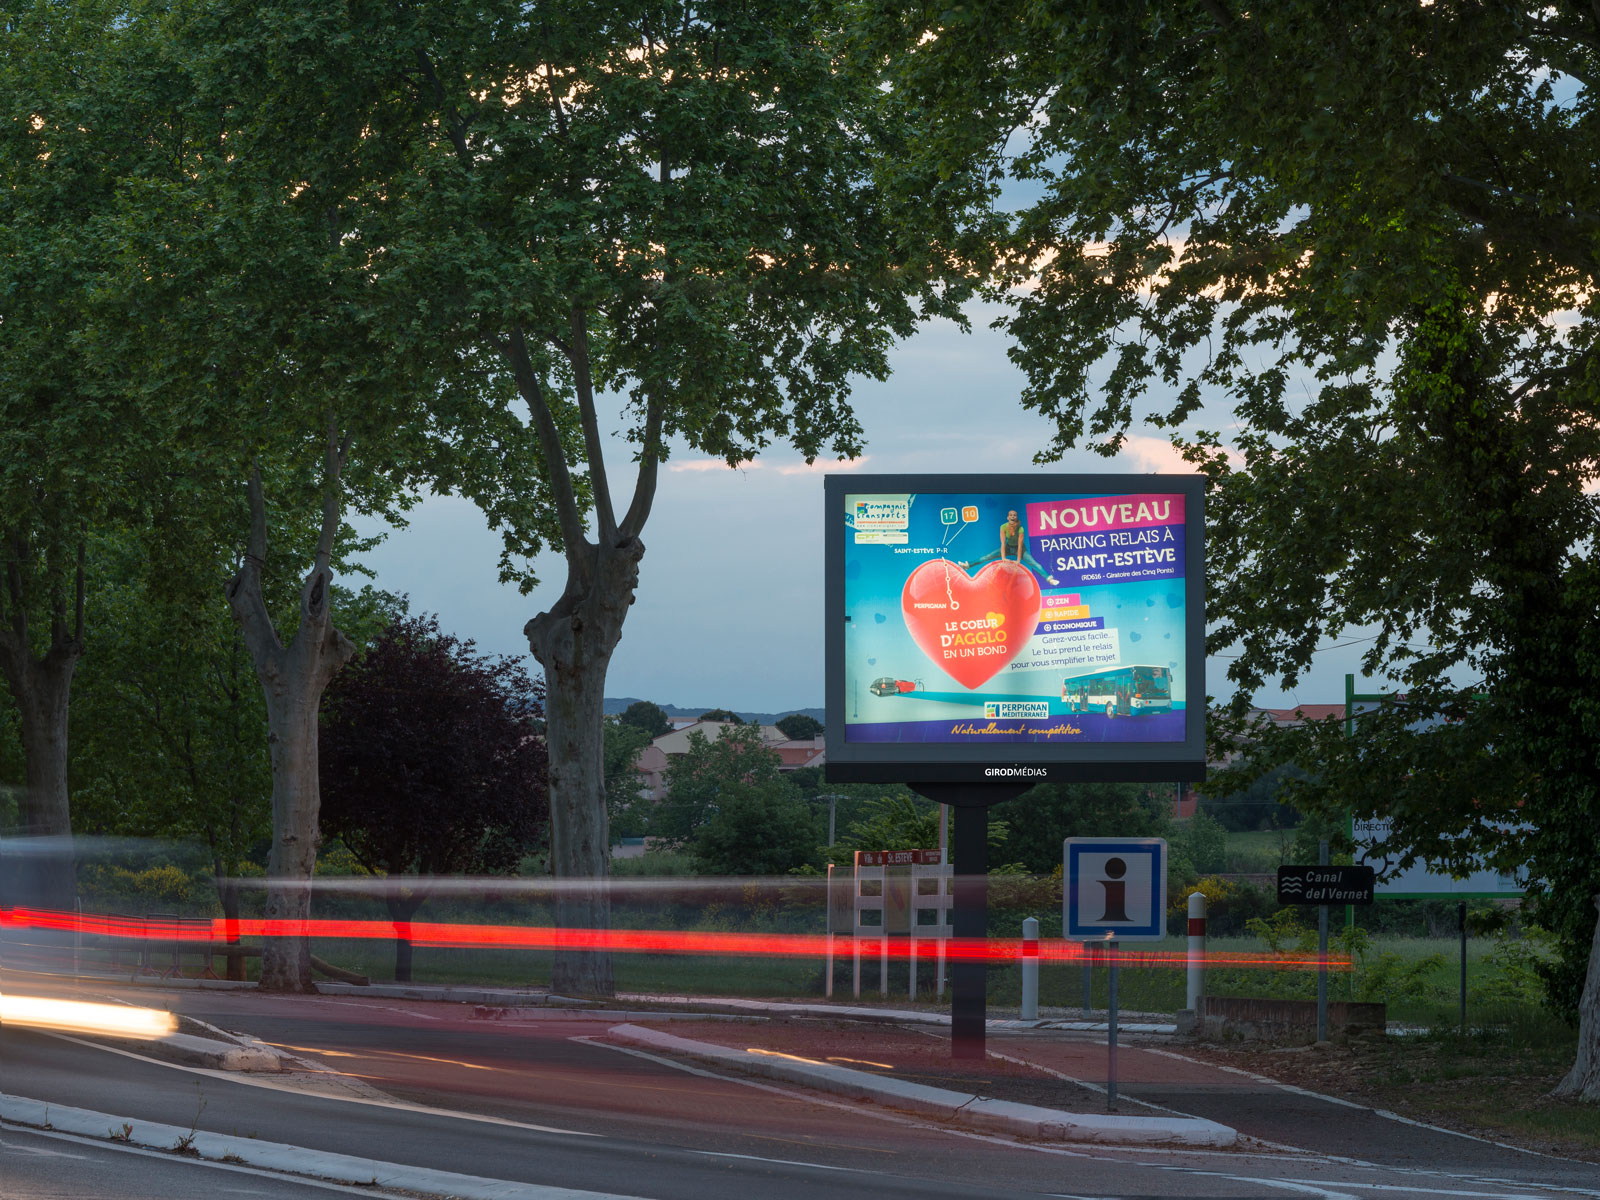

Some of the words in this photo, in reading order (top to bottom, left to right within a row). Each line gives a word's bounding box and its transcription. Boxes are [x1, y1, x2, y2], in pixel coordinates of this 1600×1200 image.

[944, 511, 954, 520] 17
[965, 510, 976, 518] 10
[1039, 500, 1171, 530] NOUVEAU
[1040, 534, 1107, 552] PARKING
[1109, 529, 1160, 546] RELAIS
[1163, 526, 1175, 542] À
[1056, 547, 1176, 571] SAINT-ESTÈVE
[1106, 570, 1130, 579] Giratoire
[1131, 569, 1142, 577] des
[1142, 568, 1156, 576] Cinq
[1055, 597, 1069, 605] ZEN
[1054, 609, 1079, 617] RAPIDE
[945, 621, 958, 632] LE
[1053, 620, 1097, 630] ÉCONOMIQUE
[940, 630, 1007, 647] D'AGGLO
[1042, 634, 1086, 644] Garez-vous
[1088, 631, 1114, 641] facile...
[943, 649, 957, 659] EN
[960, 647, 975, 658] UN
[977, 645, 1007, 656] BOND
[1032, 648, 1041, 656] Le
[1043, 646, 1057, 655] bus
[1059, 645, 1082, 657] prend
[1083, 644, 1090, 653] le
[1092, 642, 1113, 652] relais
[1011, 662, 1029, 670] pour
[1051, 656, 1085, 668] simplifier
[1087, 655, 1093, 663] le
[1096, 653, 1116, 664] trajet
[1001, 703, 1047, 712] PERPIGNAN
[951, 722, 1026, 735] Naturellement
[984, 766, 1047, 777] GIRODMÉDIAS
[1306, 871, 1342, 883] Canal
[1306, 888, 1326, 899] del
[1328, 888, 1368, 899] Vernet
